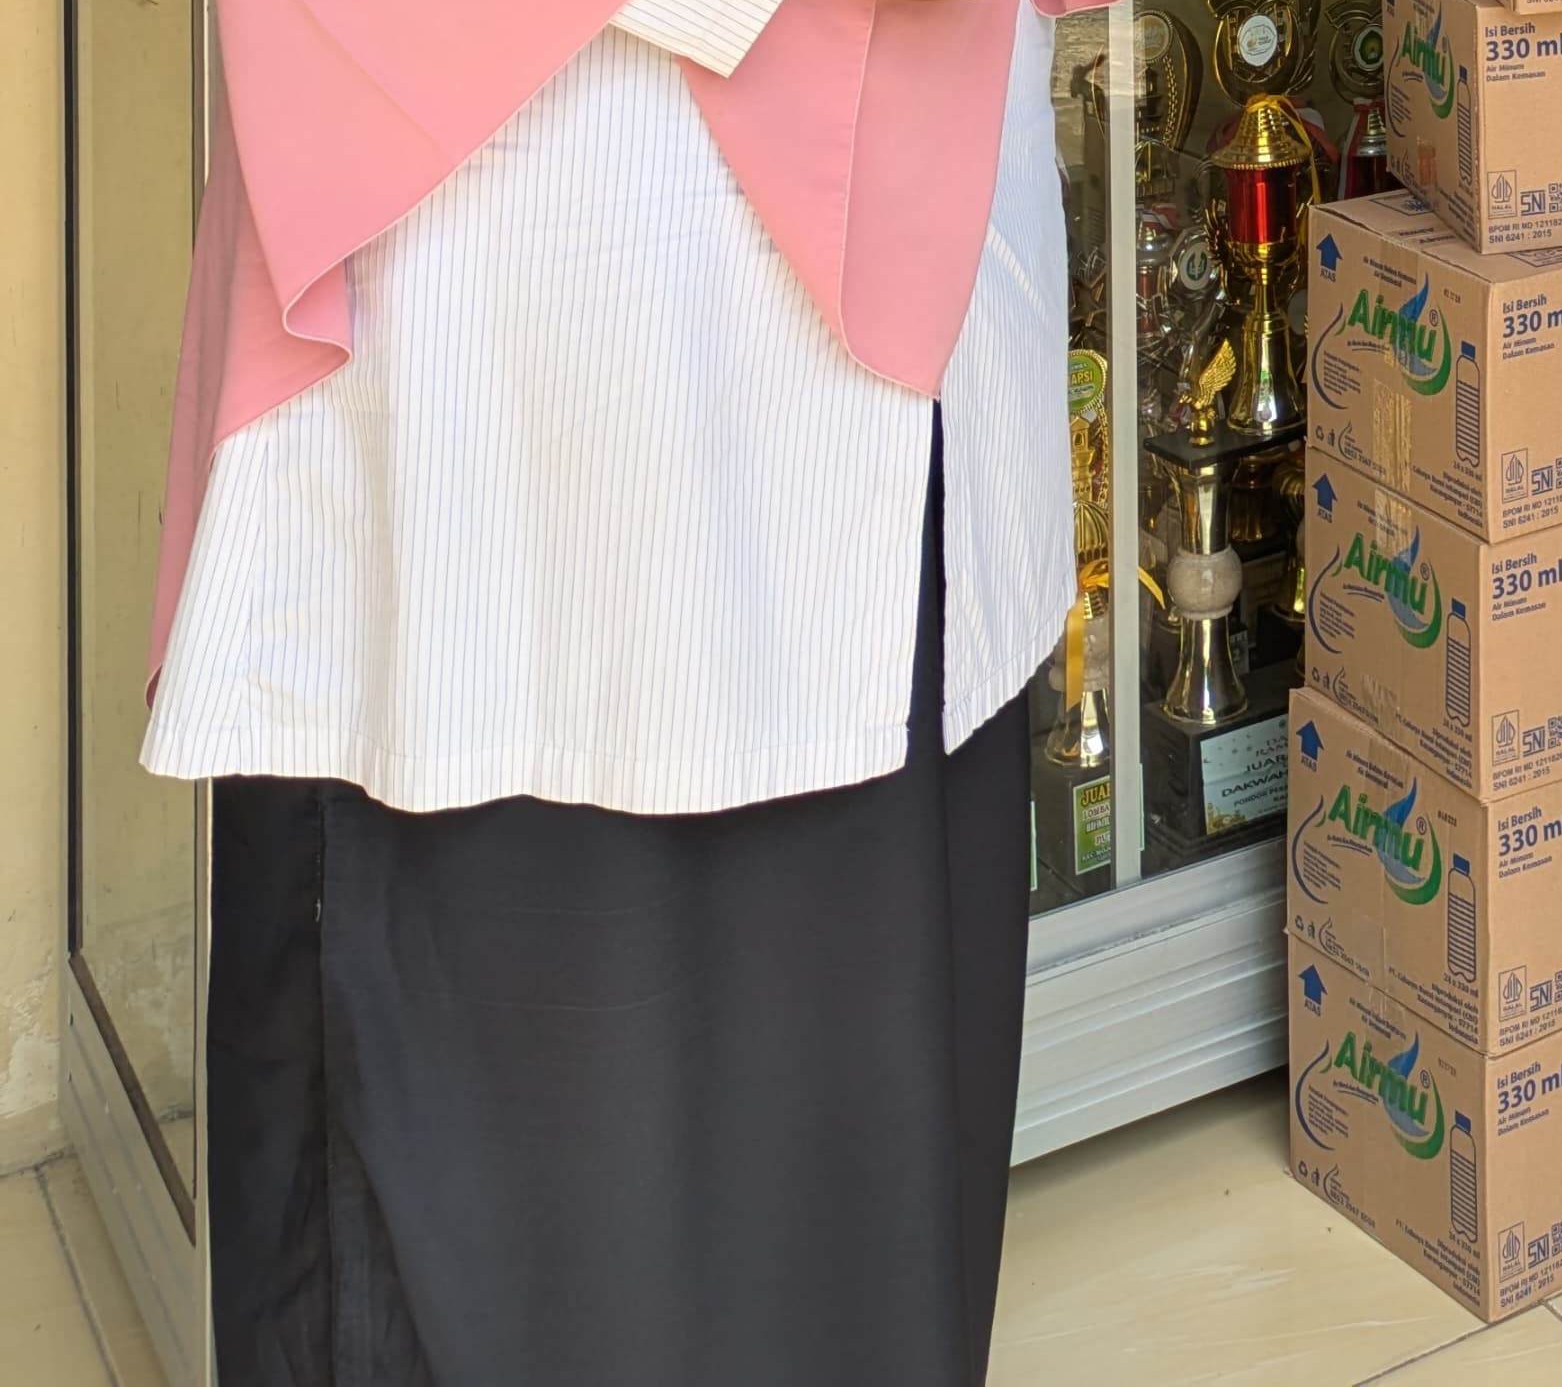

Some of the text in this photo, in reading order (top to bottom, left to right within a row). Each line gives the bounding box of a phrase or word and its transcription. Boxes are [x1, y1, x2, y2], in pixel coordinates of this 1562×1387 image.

[1485, 22, 1535, 37] Isi Bersih
[1400, 27, 1449, 83] Airmu
[1485, 37, 1530, 61] 330
[1319, 266, 1337, 283] ATAS
[1502, 293, 1547, 313] Isi Bersih
[1347, 288, 1437, 363] Airmu
[1503, 309, 1542, 338] 330
[1070, 370, 1094, 386] APSI
[1316, 506, 1334, 524] ATAS
[1344, 531, 1428, 614] Airmu
[1491, 552, 1537, 574] Isi Bersih
[1491, 568, 1532, 600] 330
[1243, 754, 1288, 773] JUAR
[1081, 781, 1111, 807] JUA
[1329, 784, 1425, 873] Airmu
[1497, 806, 1542, 831] Isi Bersih
[1498, 822, 1538, 857] 330
[1303, 998, 1322, 1018] ATAS
[1333, 1030, 1430, 1126] Airmu
[1497, 1060, 1540, 1090] Isi Bersih
[1498, 1076, 1536, 1115] 330
